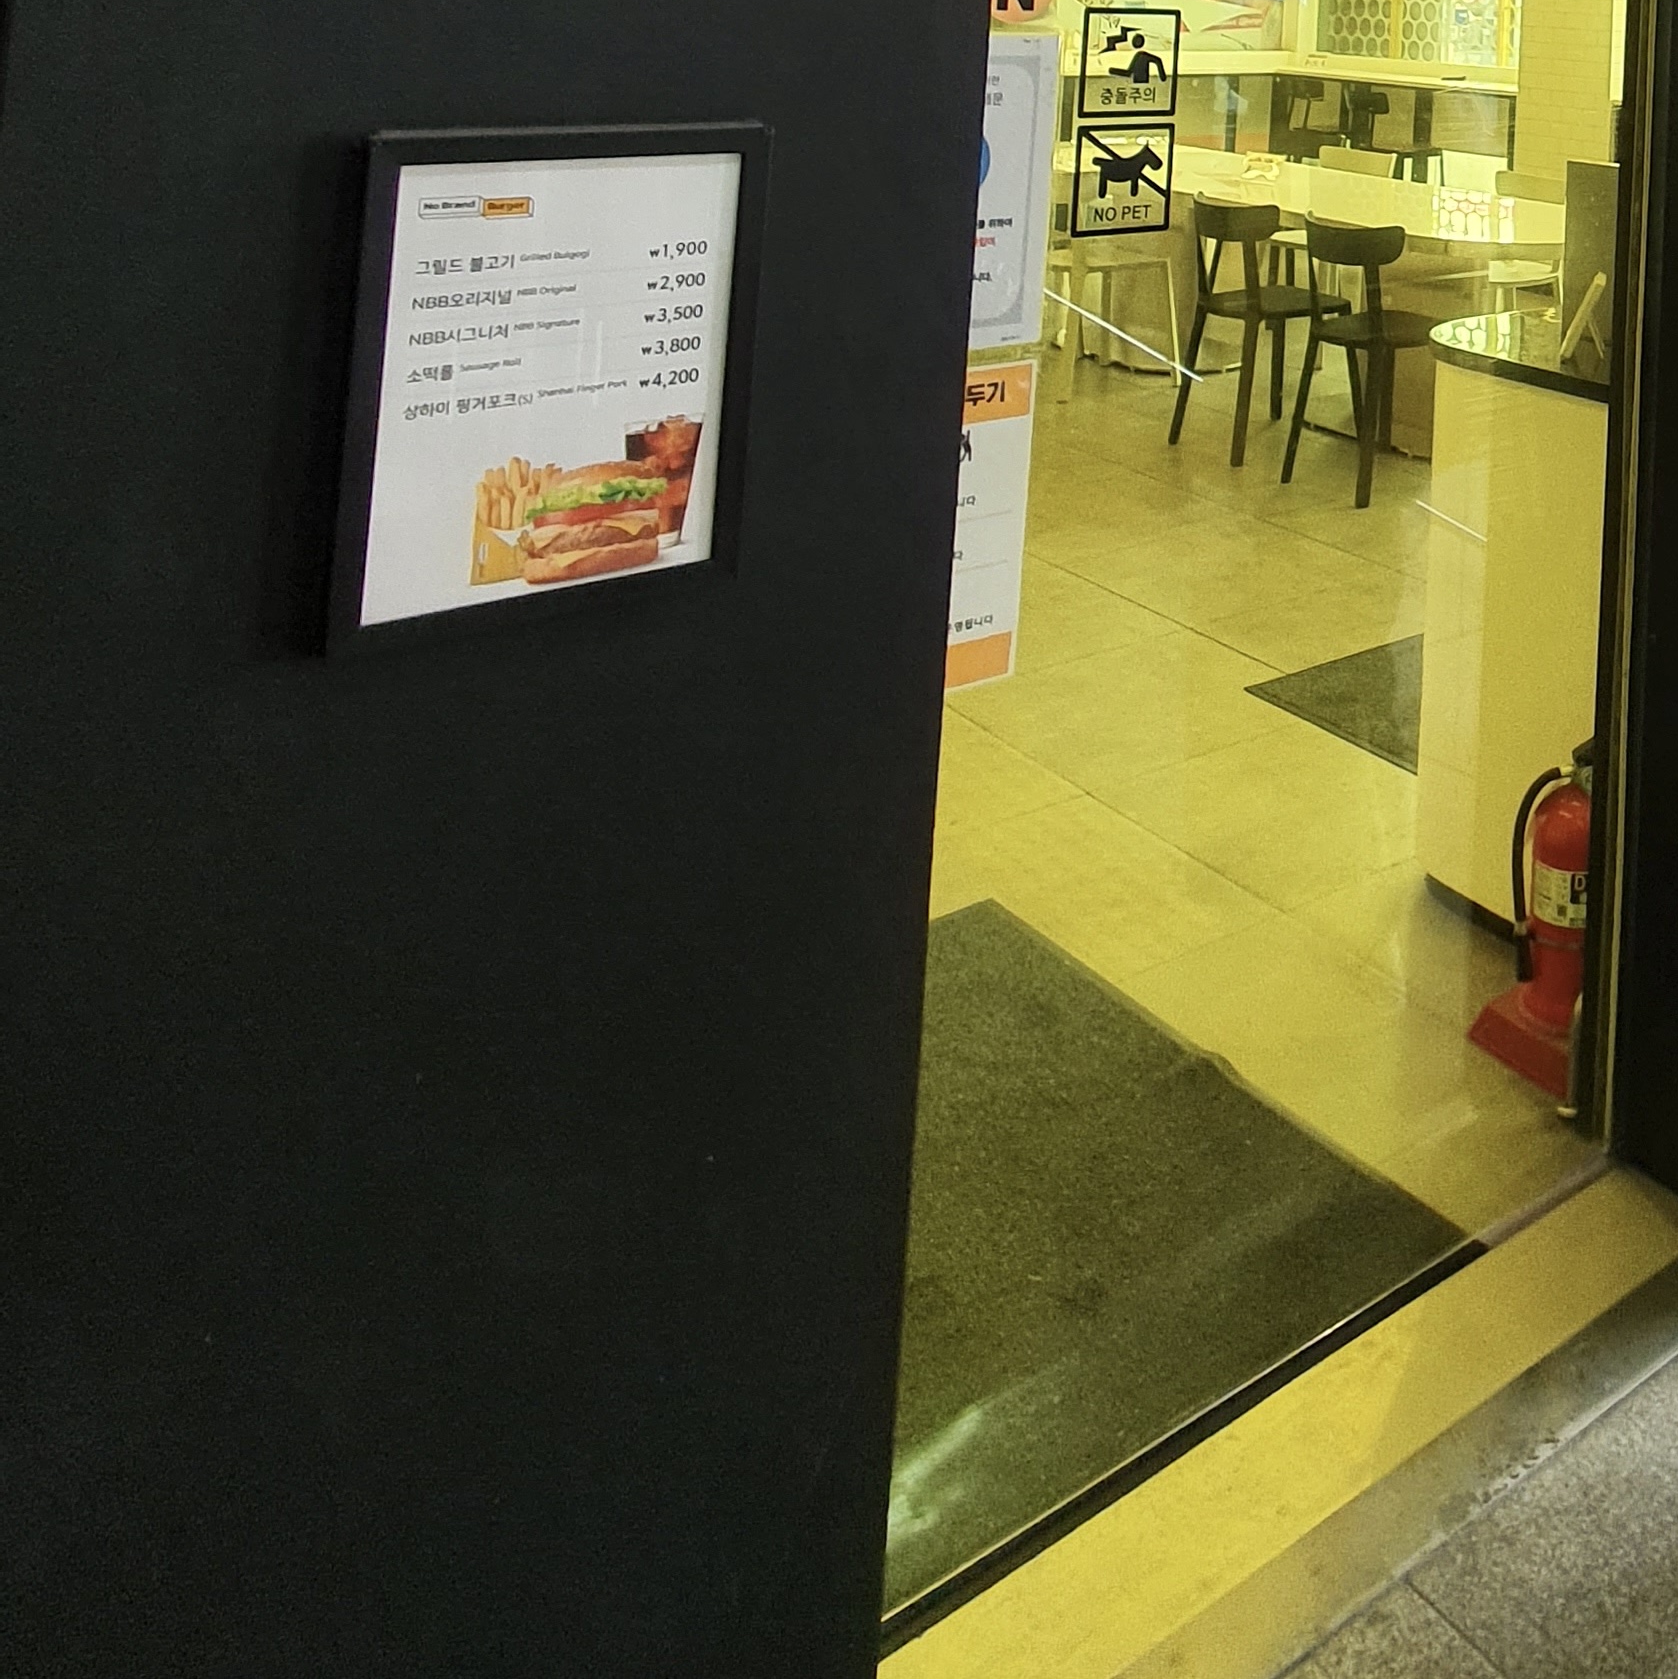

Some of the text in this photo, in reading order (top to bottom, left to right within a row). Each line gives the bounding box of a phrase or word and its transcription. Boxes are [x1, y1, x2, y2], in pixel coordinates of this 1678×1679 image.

[1101, 86, 1156, 105] 충돌주의
[487, 201, 525, 212] Burger
[1094, 205, 1152, 223] NO PET
[415, 254, 515, 275] 그릴드 불고기
[411, 289, 512, 310] NBB오리지널
[409, 324, 509, 347] NBB시그니처
[965, 380, 1005, 406] 두기
[403, 401, 450, 421] 상하이
